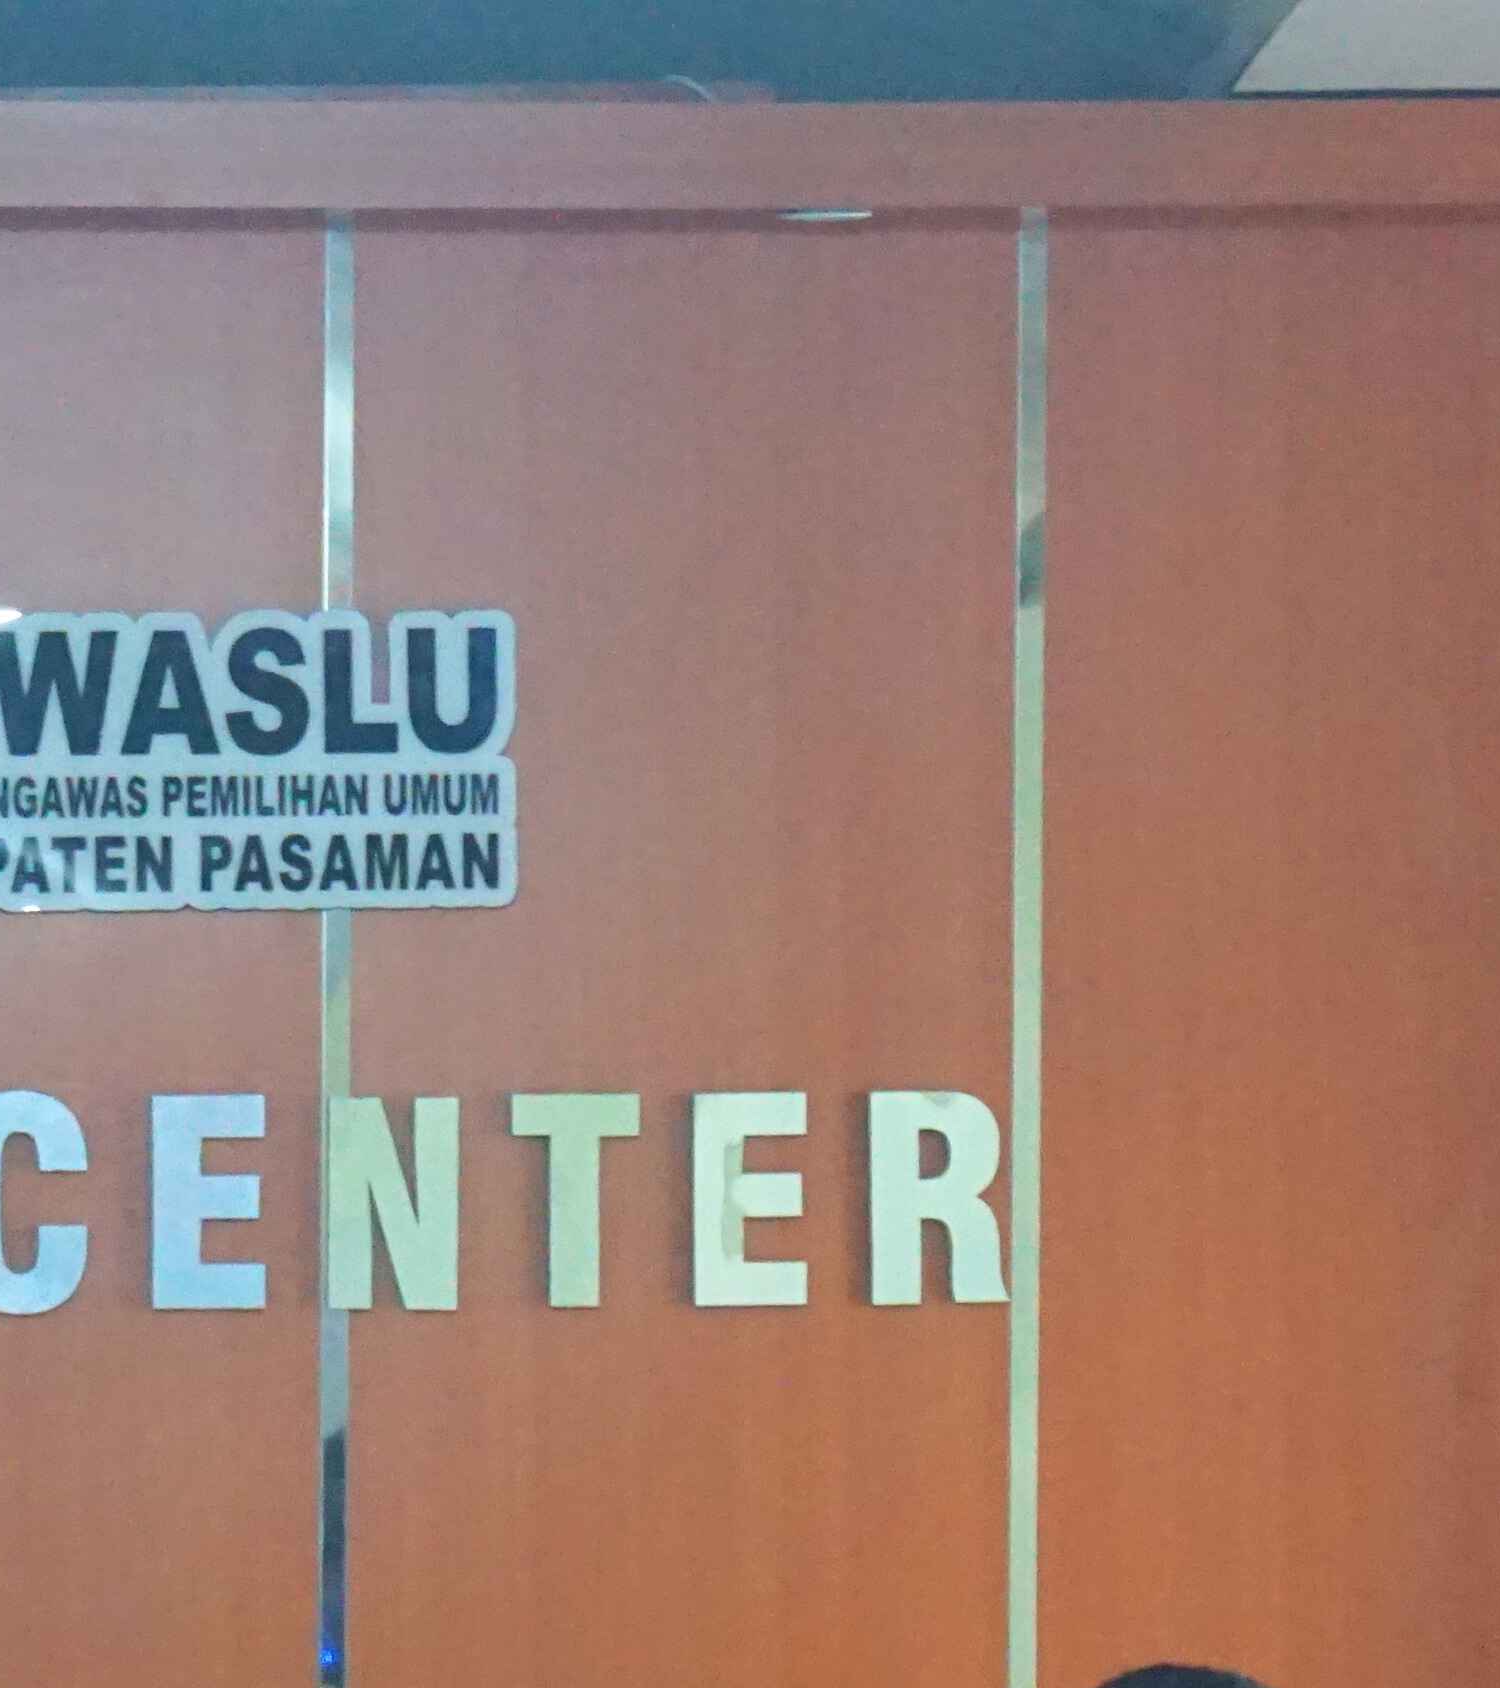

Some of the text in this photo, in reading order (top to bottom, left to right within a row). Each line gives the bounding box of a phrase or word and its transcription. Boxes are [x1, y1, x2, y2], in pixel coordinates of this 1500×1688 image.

[162, 775, 369, 818] PEMILIHAN
[383, 773, 499, 816] UMUM
[200, 832, 499, 892] PASAMAN
